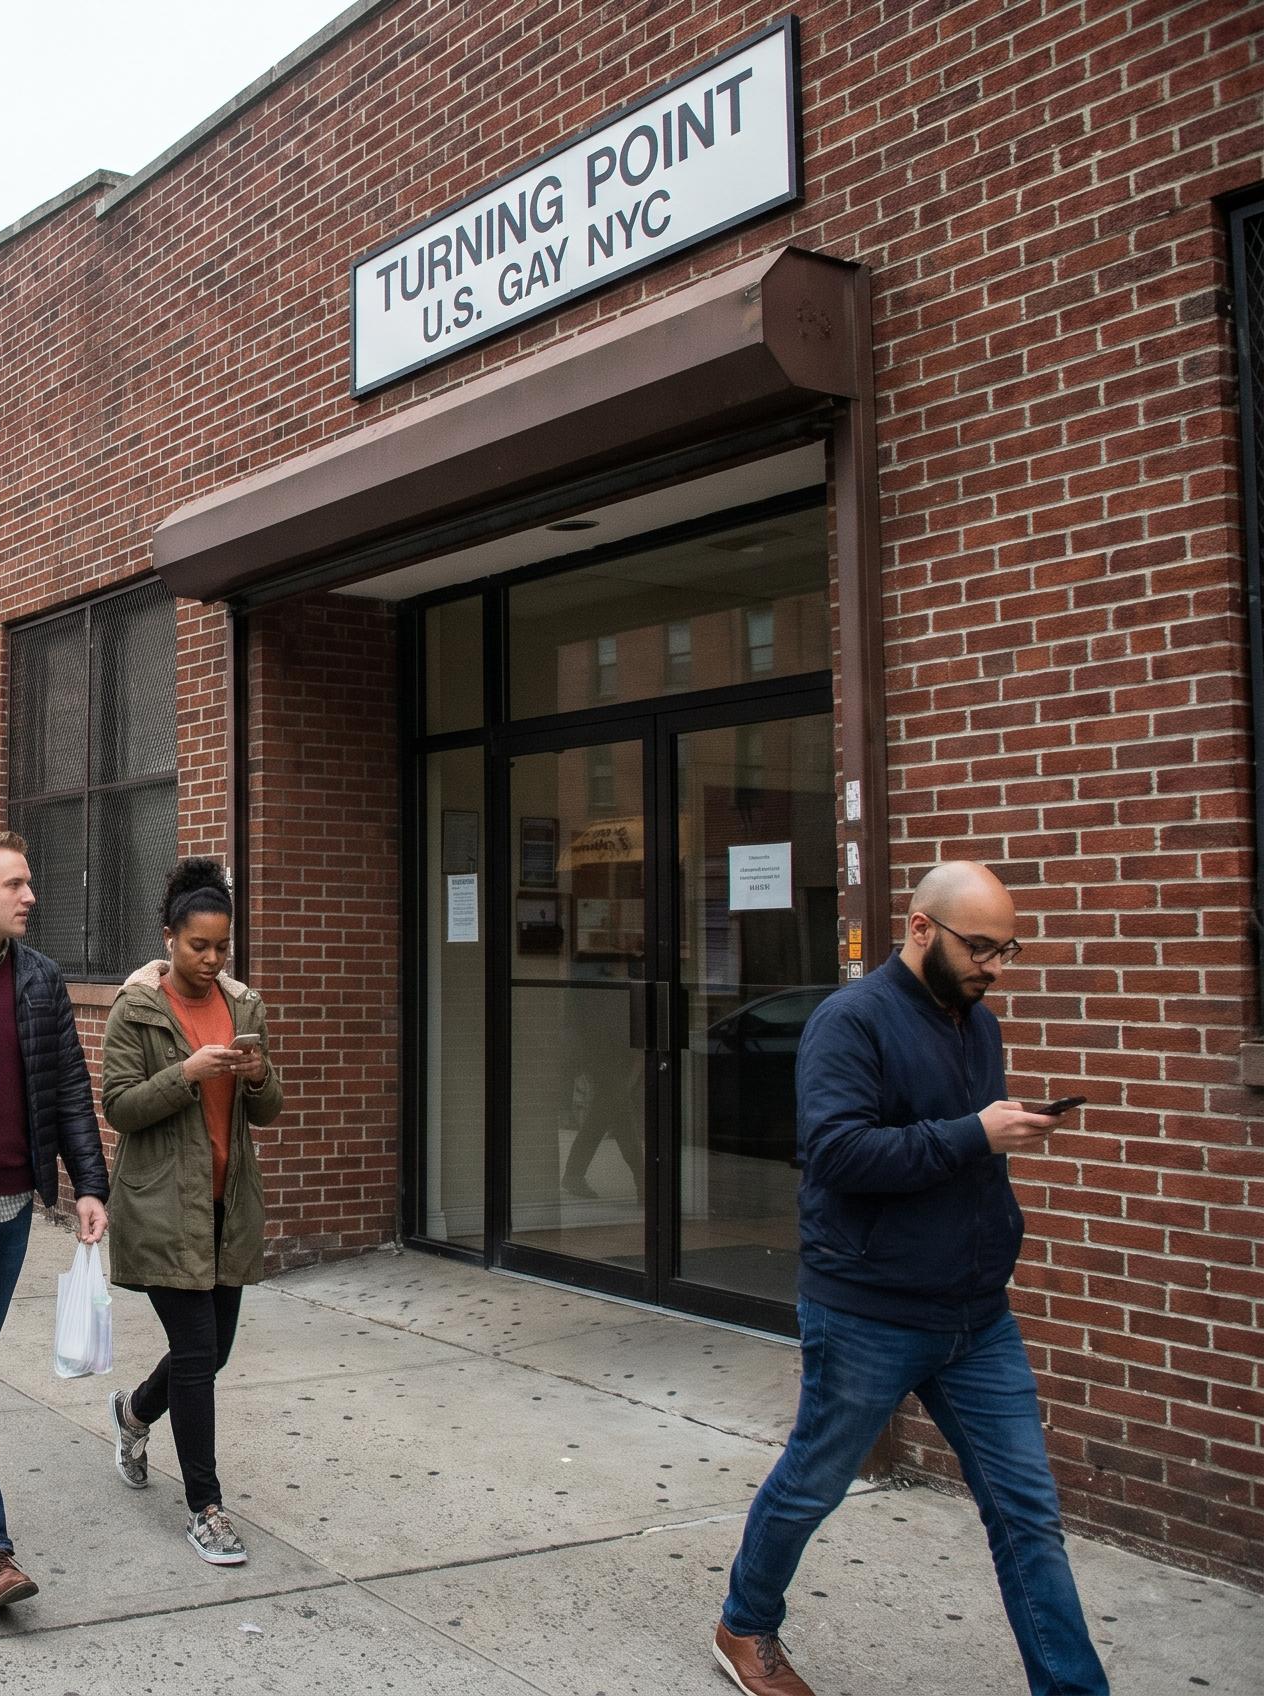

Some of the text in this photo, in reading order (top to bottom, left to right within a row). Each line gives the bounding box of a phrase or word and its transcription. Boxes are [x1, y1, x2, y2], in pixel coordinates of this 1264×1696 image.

[376, 66, 753, 312] TURNING POINT
[422, 189, 672, 343] U.S. GAY NYC
